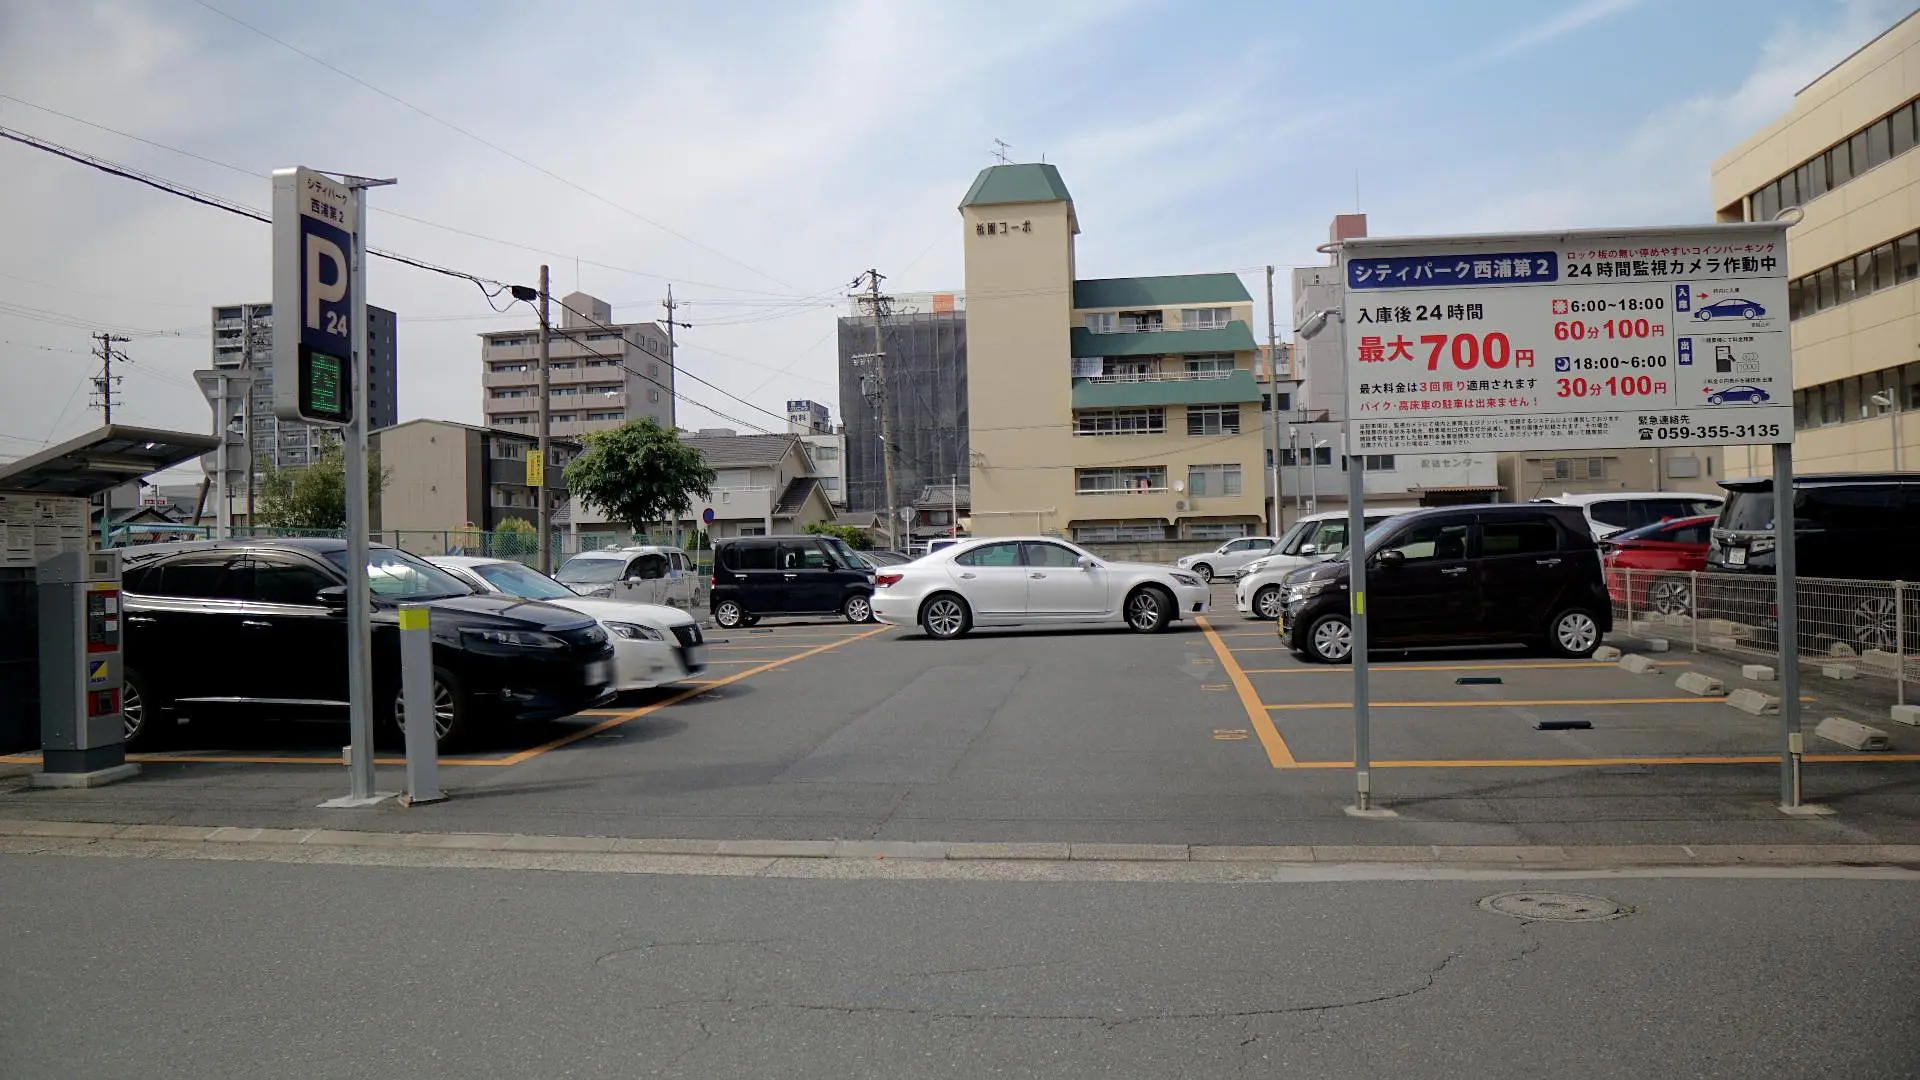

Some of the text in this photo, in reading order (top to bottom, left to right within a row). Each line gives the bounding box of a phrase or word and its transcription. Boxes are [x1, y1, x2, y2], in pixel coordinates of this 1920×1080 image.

[307, 178, 348, 205] シティパーク
[311, 198, 344, 223] 西浦第2
[1355, 259, 1549, 282] シティパーク西浦第2
[1567, 256, 1777, 278] 24時間監視カメラ作動中
[306, 233, 348, 338] P 24
[1357, 304, 1484, 324] 入庫後24時間
[1358, 332, 1535, 371] 最大700円
[1680, 342, 1691, 363] 出庫
[1359, 378, 1538, 395] 最大料金は3回限り適用されます
[1638, 414, 1691, 426] 緊急連絡先
[1657, 424, 1780, 440] 059-355-3135
